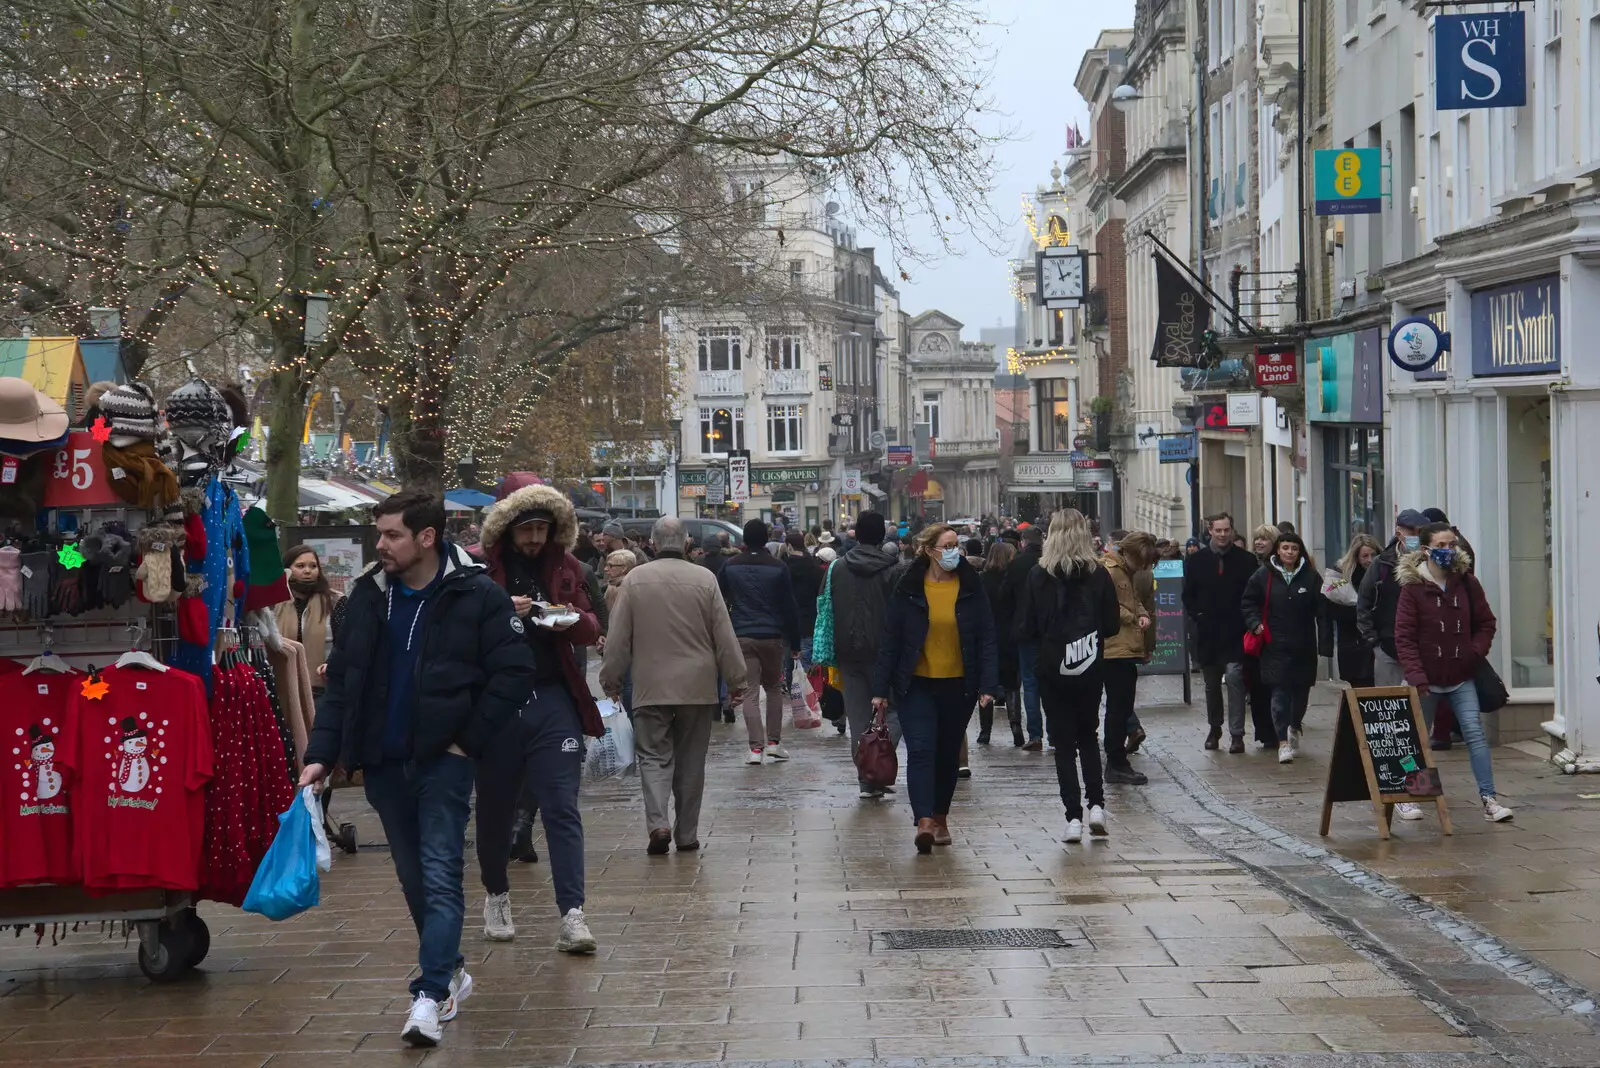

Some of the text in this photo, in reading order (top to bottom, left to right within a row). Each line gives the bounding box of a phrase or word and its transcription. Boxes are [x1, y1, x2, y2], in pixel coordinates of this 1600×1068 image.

[1461, 19, 1500, 38] WH
[1461, 38, 1501, 100] S
[1489, 285, 1557, 368] WHSmith
[1258, 364, 1293, 373] Phone
[1263, 372, 1289, 382] Land
[53, 448, 94, 490] £5
[762, 472, 781, 481] CIGS
[787, 470, 816, 480] PAPERS
[736, 480, 744, 490] 7
[1065, 630, 1099, 666] NIKE
[1360, 700, 1382, 712] YOU
[1378, 711, 1396, 720] BUY
[1364, 719, 1410, 734] HAPPINESS
[1367, 740, 1381, 748] YOU
[1396, 737, 1410, 746] BUY
